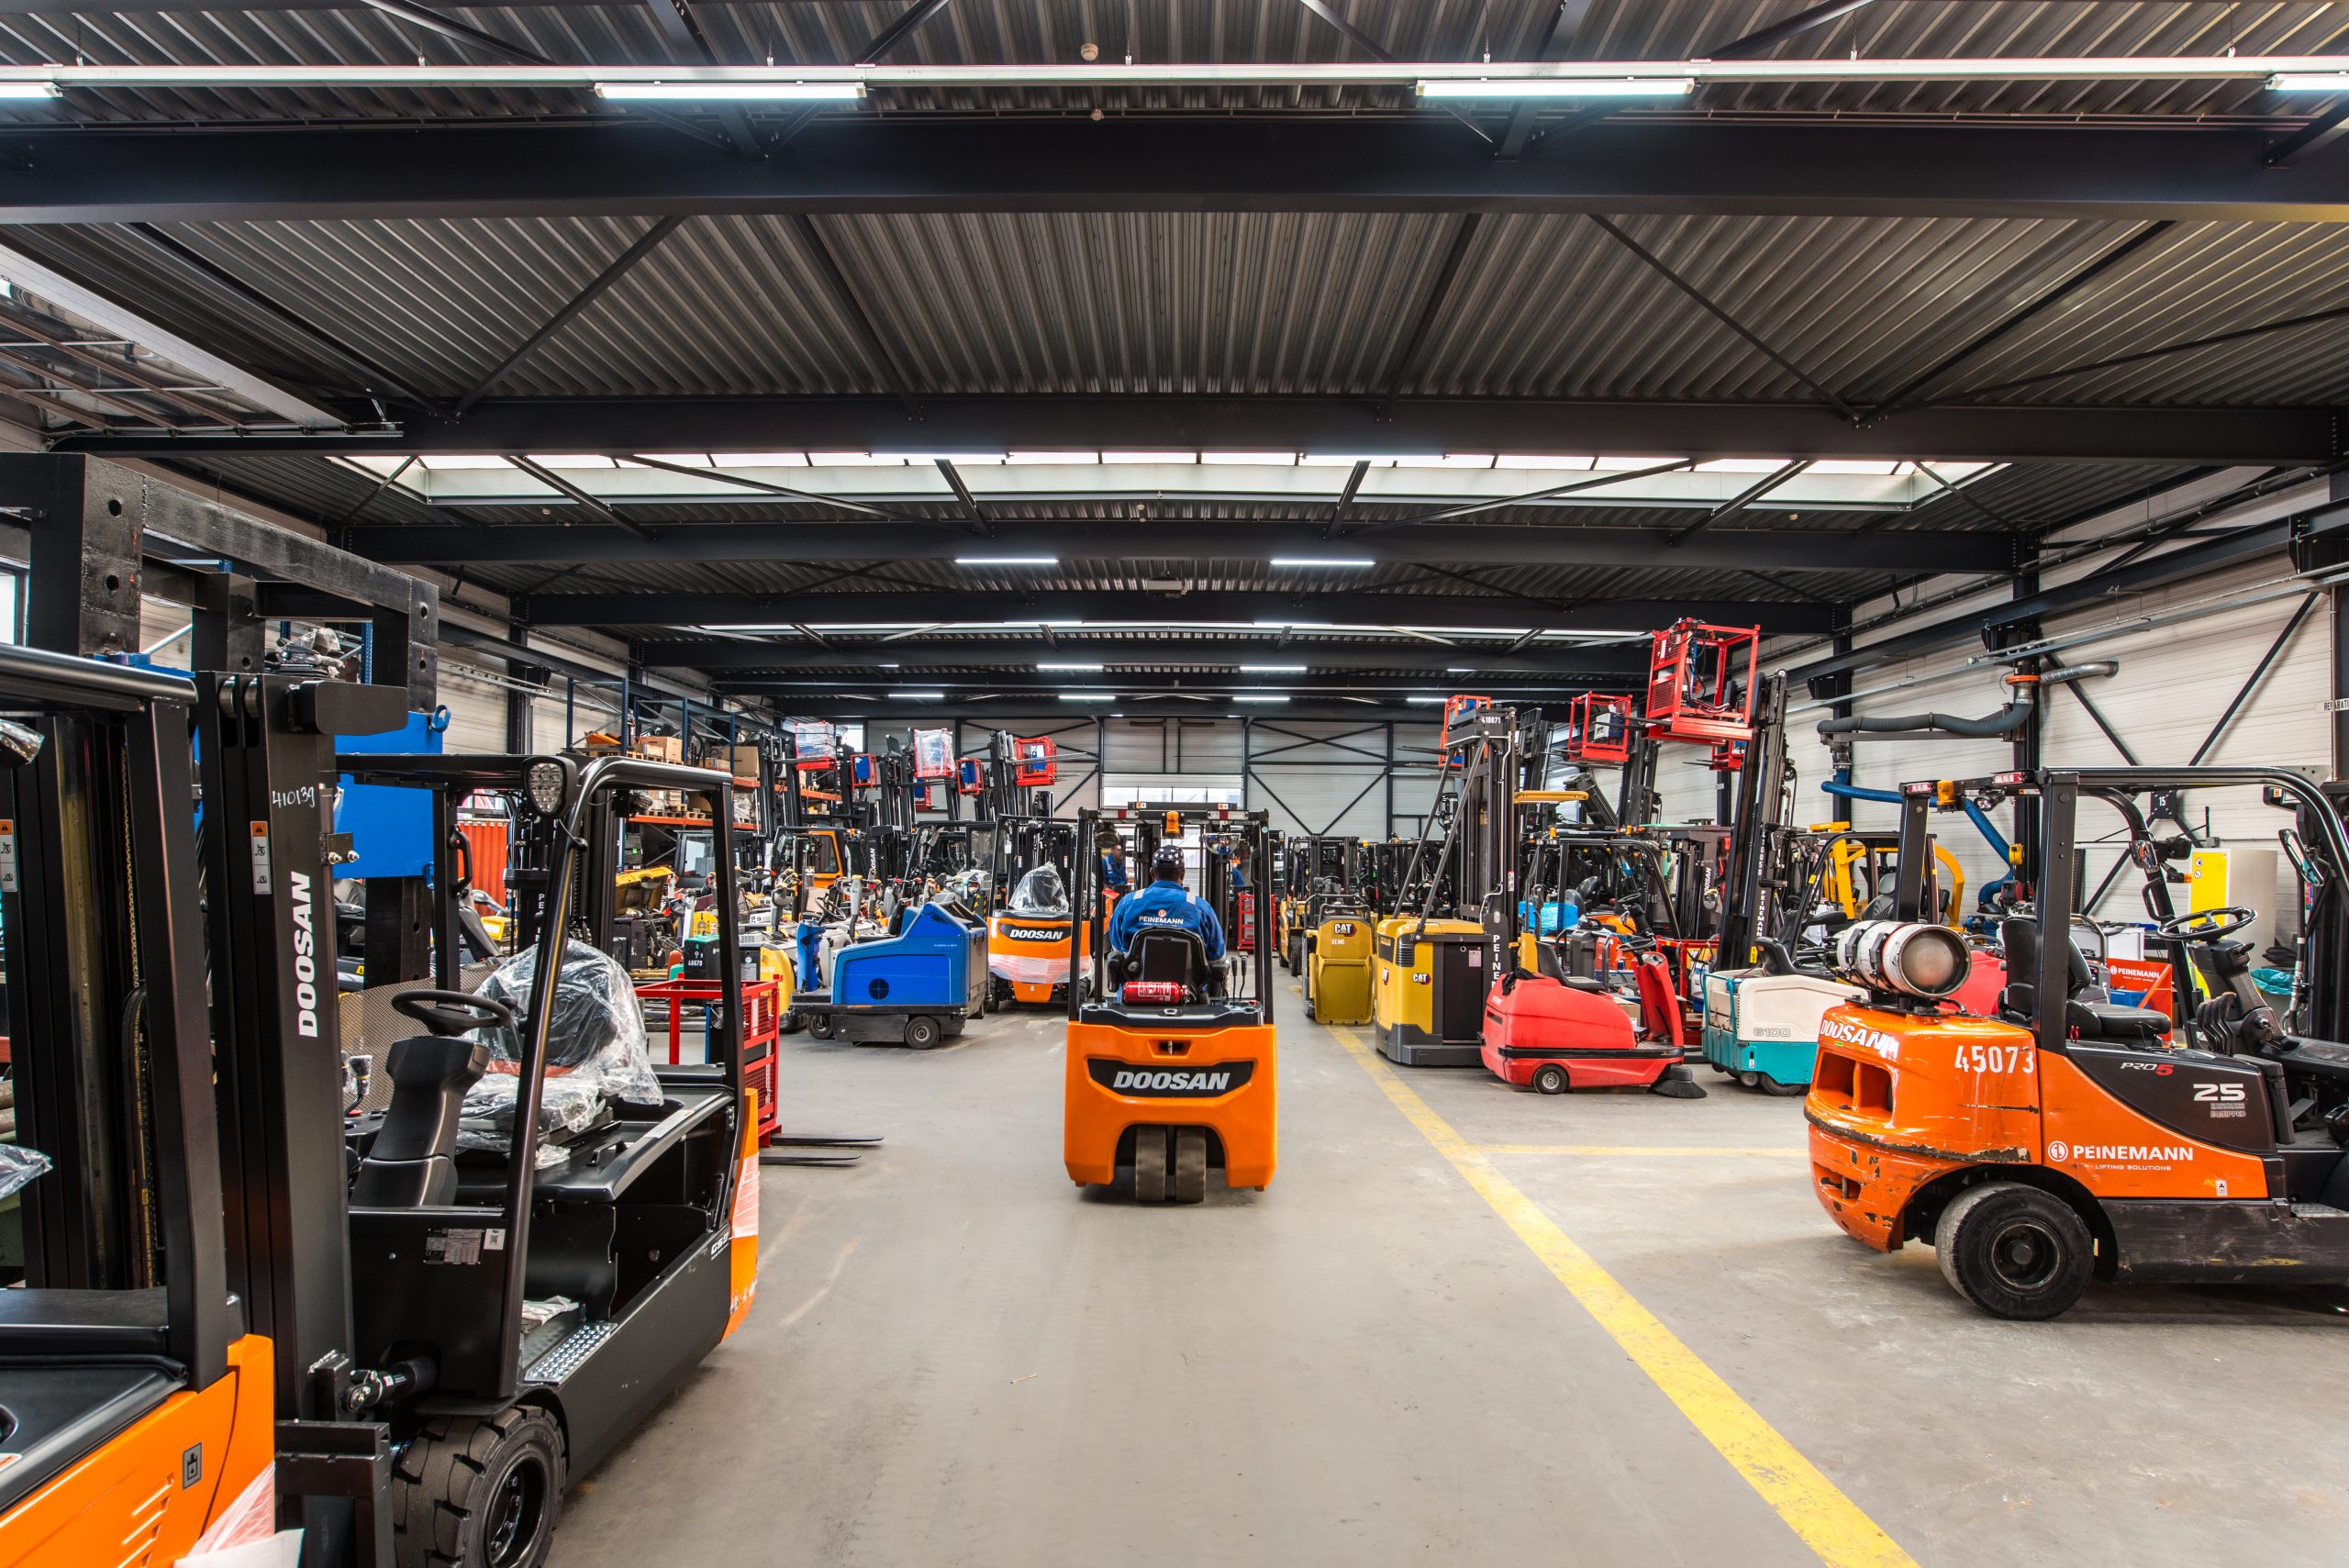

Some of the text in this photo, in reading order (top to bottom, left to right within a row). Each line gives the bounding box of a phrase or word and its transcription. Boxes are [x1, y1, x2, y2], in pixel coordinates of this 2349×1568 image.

[2324, 700, 2349, 710] REPRAT
[2159, 796, 2166, 806] 15
[1139, 916, 1184, 925] PEINEMANN
[1756, 890, 1766, 937] PEINEMANN
[1009, 929, 1063, 940] DOOSAN
[1334, 923, 1353, 934] CAT
[291, 871, 318, 1038] DOOSAN
[1492, 934, 1501, 989] PEINE
[1413, 973, 1428, 984] CAT
[2118, 967, 2160, 979] PEINEMANN
[1954, 1045, 2034, 1073] 45073
[1113, 1071, 1230, 1090] DOOSAN
[2193, 1083, 2246, 1102] 25
[2073, 1145, 2194, 1161] PEINEMANN
